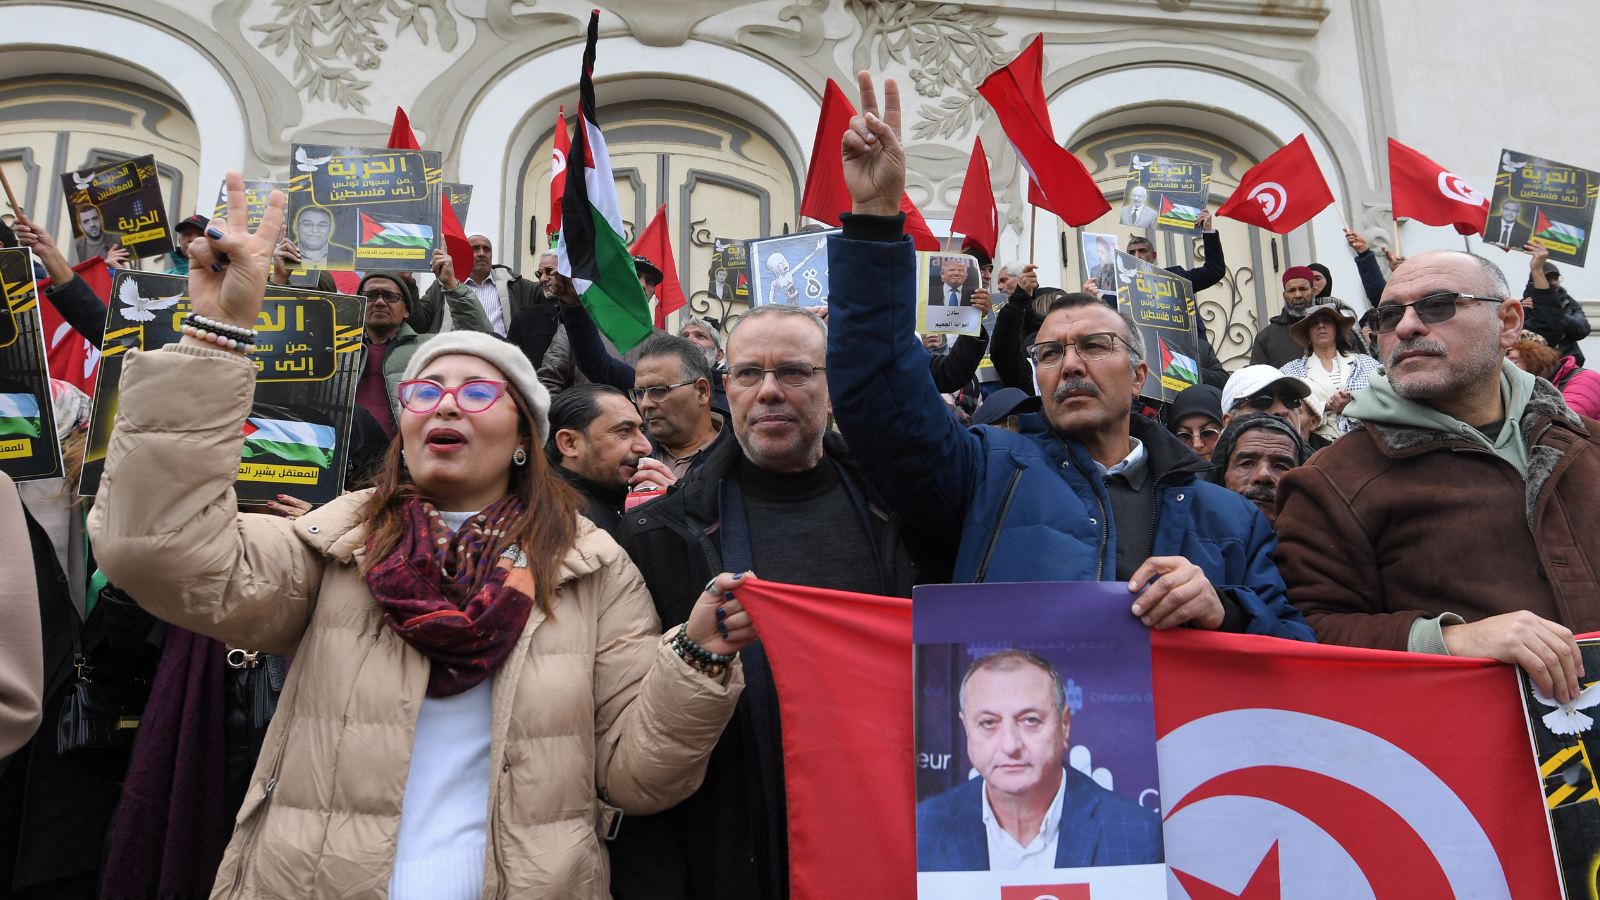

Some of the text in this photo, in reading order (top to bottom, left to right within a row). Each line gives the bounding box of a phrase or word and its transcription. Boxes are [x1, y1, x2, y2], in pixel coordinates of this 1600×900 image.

[327, 157, 407, 179] الحرية
[1148, 163, 1192, 177] الحرية
[1521, 165, 1576, 185] الحرية
[332, 180, 359, 188] تونس
[362, 179, 390, 187] سجون
[1181, 183, 1195, 191] إلى
[330, 186, 415, 200] إلى فلسطين
[1520, 190, 1579, 205] إلى فلسطين
[118, 210, 159, 231] الحرية
[1135, 273, 1178, 300] الحرية
[1140, 299, 1181, 312] من سجون تونس
[1140, 309, 1185, 327] إلى فلسطين
[935, 321, 953, 329] الجحيم
[285, 342, 307, 354] من
[275, 357, 314, 376] إلى
[0, 443, 24, 453] للمعت
[253, 467, 276, 478] بشير
[278, 468, 318, 479] للمعتقل
